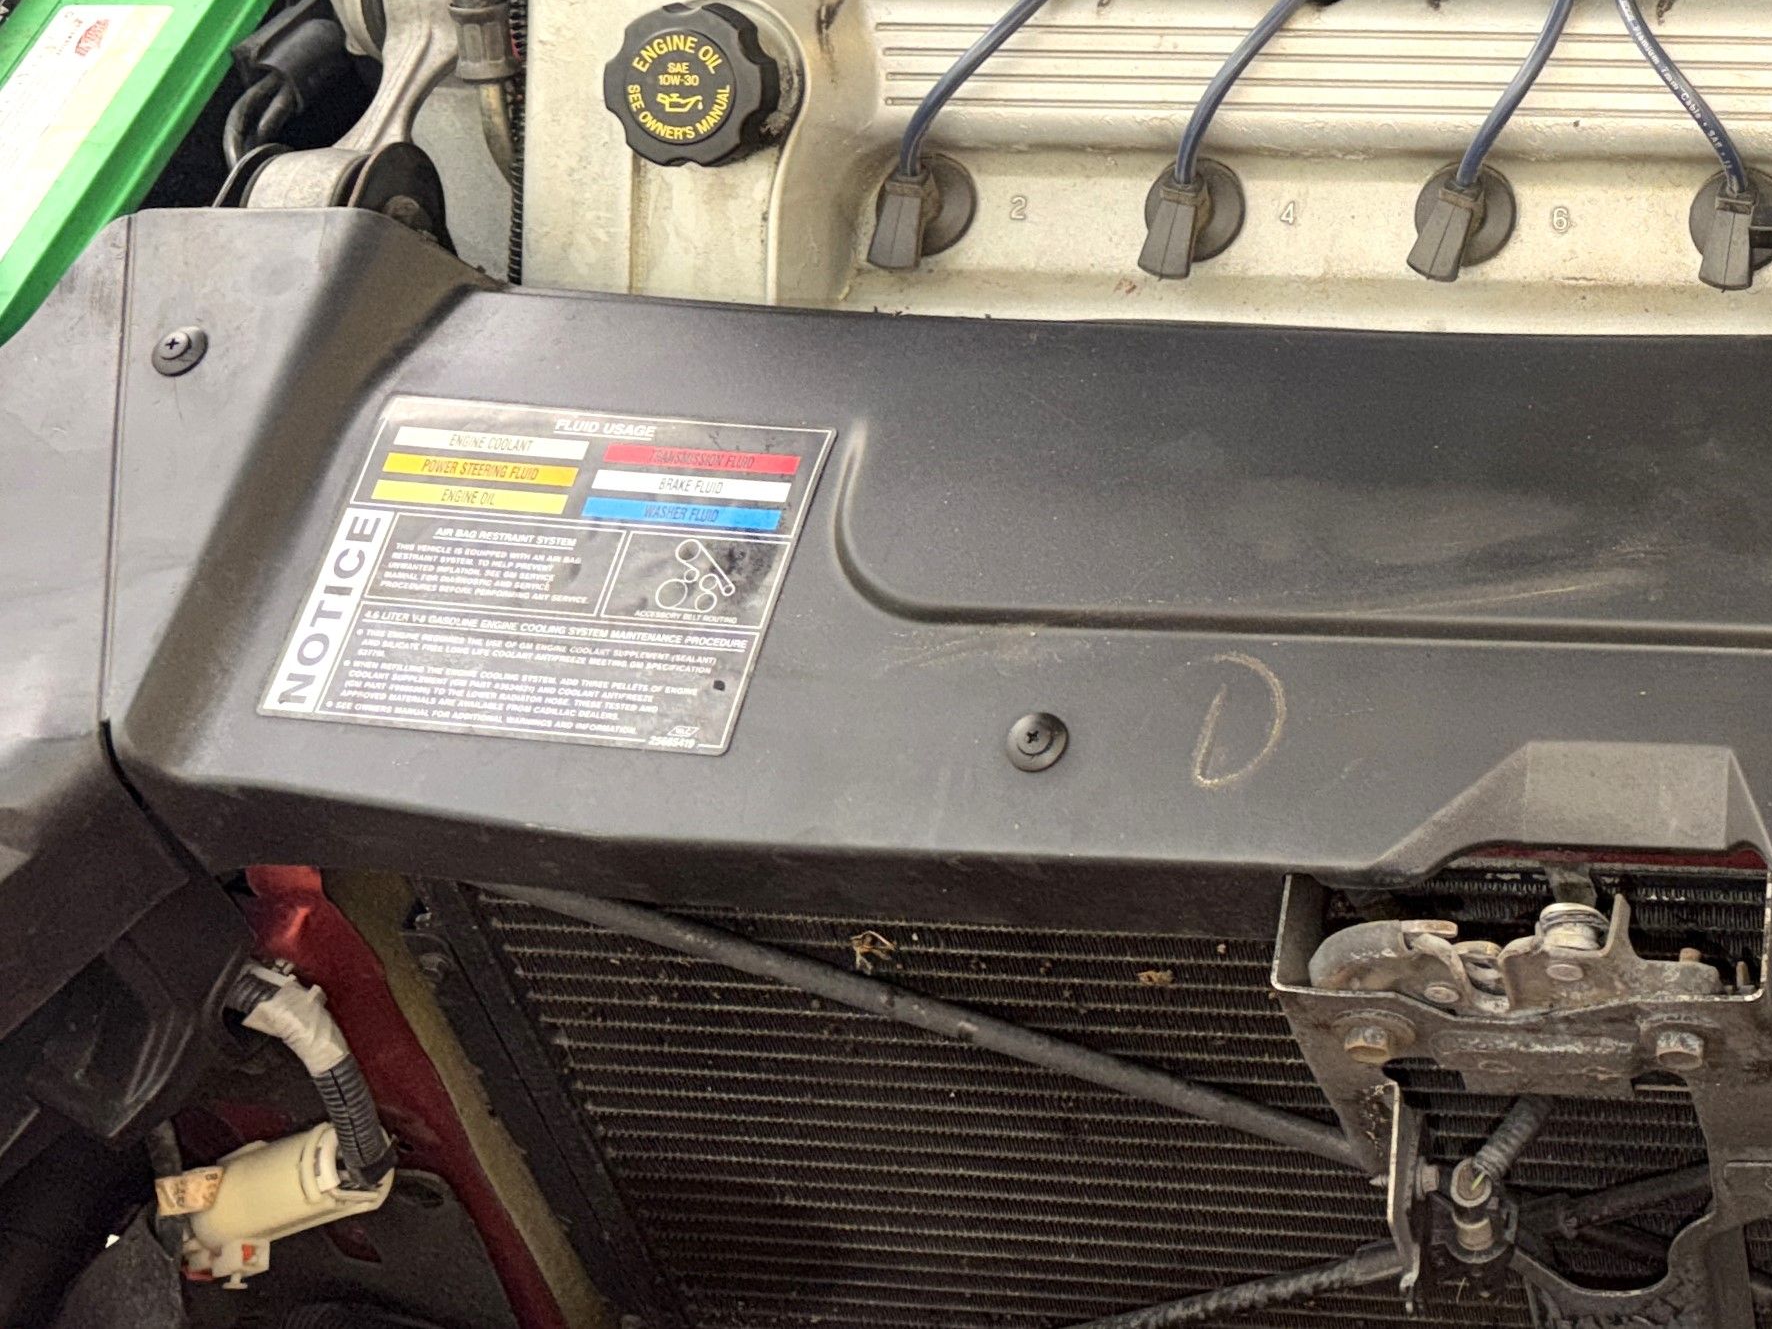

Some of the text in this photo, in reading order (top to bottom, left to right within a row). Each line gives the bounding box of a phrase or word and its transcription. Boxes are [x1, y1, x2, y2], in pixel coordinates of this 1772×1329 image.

[632, 35, 723, 74] ENGINE OIL
[667, 62, 690, 74] SAE
[658, 75, 700, 86] 10W-30
[627, 84, 730, 140] SEE OWNER'S MANUAL
[1680, 90, 1703, 120] Cable
[1010, 196, 1028, 220] 2
[1280, 202, 1296, 224] 4
[1552, 208, 1570, 232] 6
[554, 419, 656, 437] FLUID USAGE
[449, 434, 533, 451] ENGINE COOLANT
[421, 459, 539, 480] POWER STEERING FLUID
[725, 455, 755, 468] FLUID
[658, 478, 723, 494] BRAKE FLUID
[441, 489, 497, 505] ENGINE OIL
[643, 505, 719, 522] WASHER FLUID
[435, 527, 577, 546] AIR BAG RESTRAINT SYSTEM
[278, 516, 381, 705] NOTICE
[381, 611, 409, 621] LITER
[427, 615, 478, 627] GASOLINE
[479, 619, 519, 630] ENGINE
[519, 623, 566, 634] COOLING
[567, 627, 608, 637] SYSTEM
[610, 630, 682, 643] MAINTENANCE
[684, 636, 747, 649] PROCEDURE
